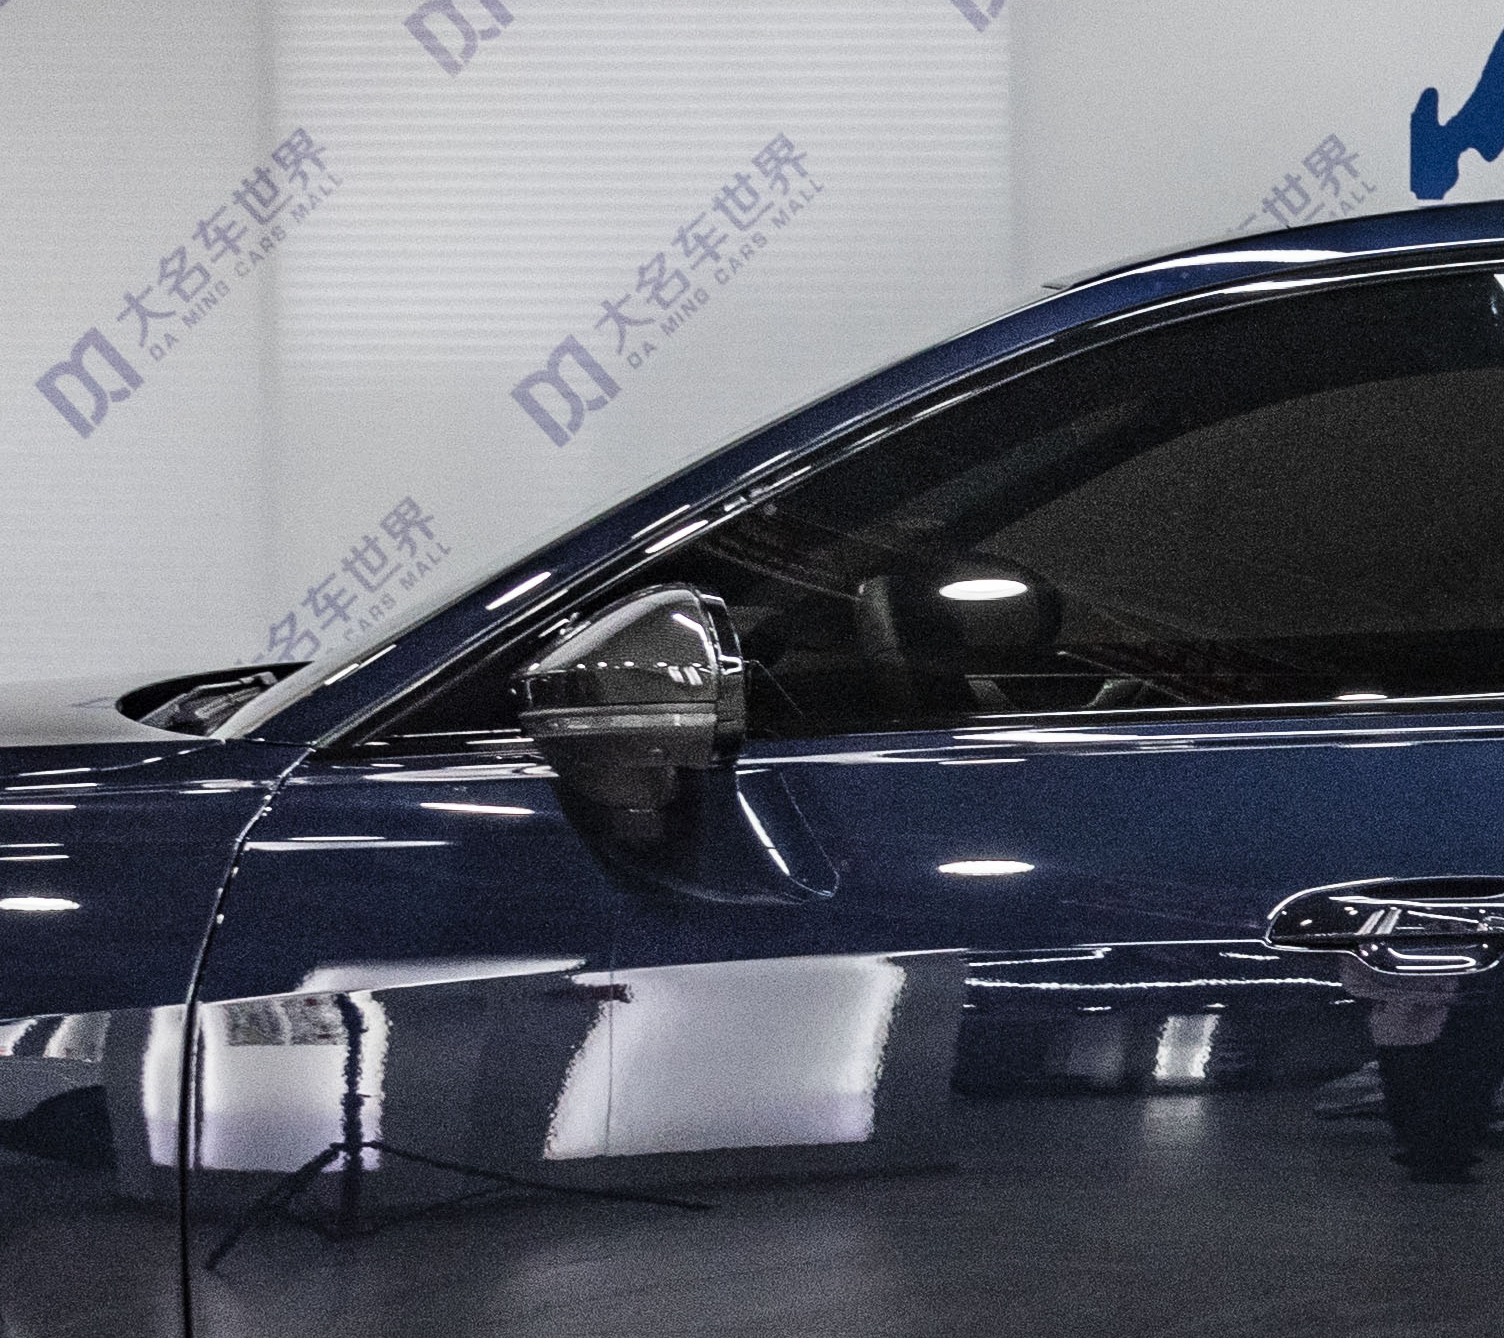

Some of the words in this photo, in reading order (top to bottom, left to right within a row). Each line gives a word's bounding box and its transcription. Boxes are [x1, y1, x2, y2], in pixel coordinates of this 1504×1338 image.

[116, 127, 327, 348] 大名车世界
[594, 134, 808, 355] 大名车世界
[235, 496, 434, 662] 名车世界
